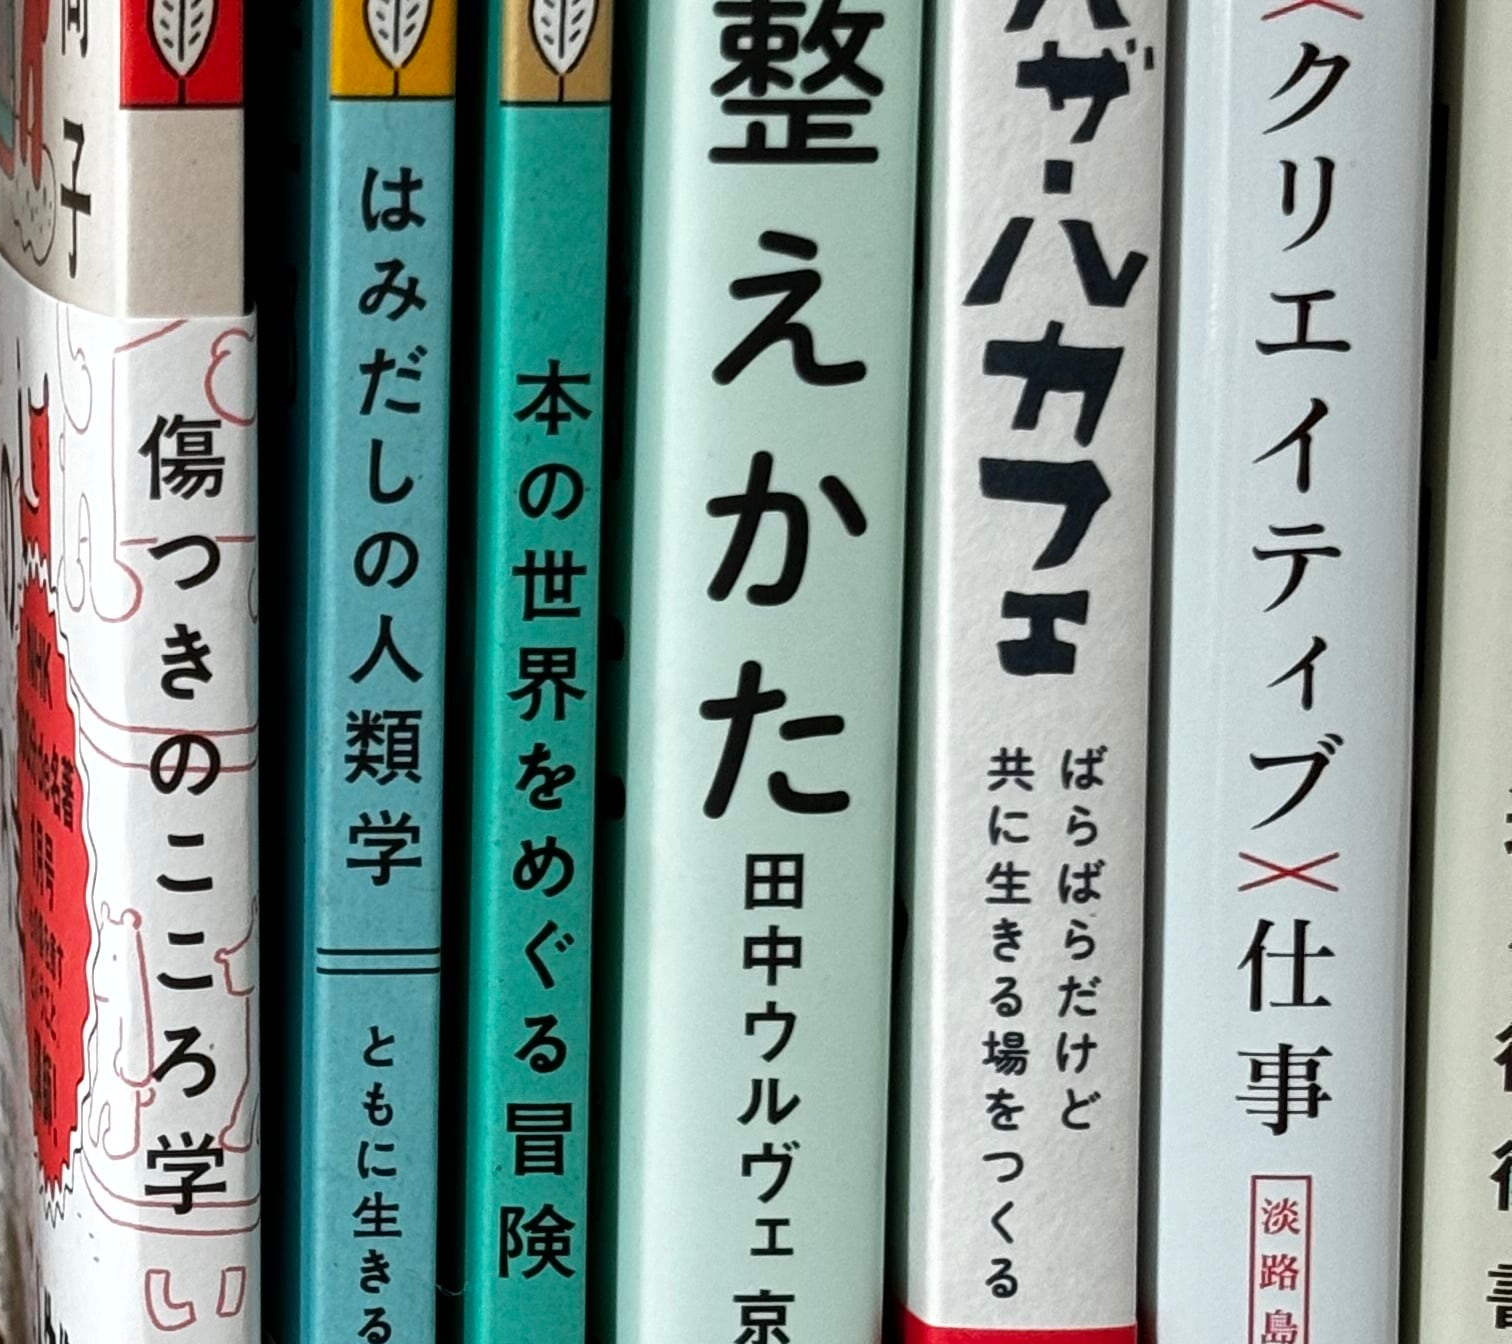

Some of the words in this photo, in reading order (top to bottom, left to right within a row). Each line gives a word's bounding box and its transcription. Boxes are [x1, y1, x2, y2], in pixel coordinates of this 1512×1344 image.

[138, 414, 228, 1215] 傷つきのこころ学
[343, 166, 426, 887] はみだしの人類学
[496, 359, 592, 1280] 本の世界をめぐる冒険
[982, 746, 1035, 1301] 共に生きる場をつくる
[1056, 746, 1109, 1133] ばらばらだけど
